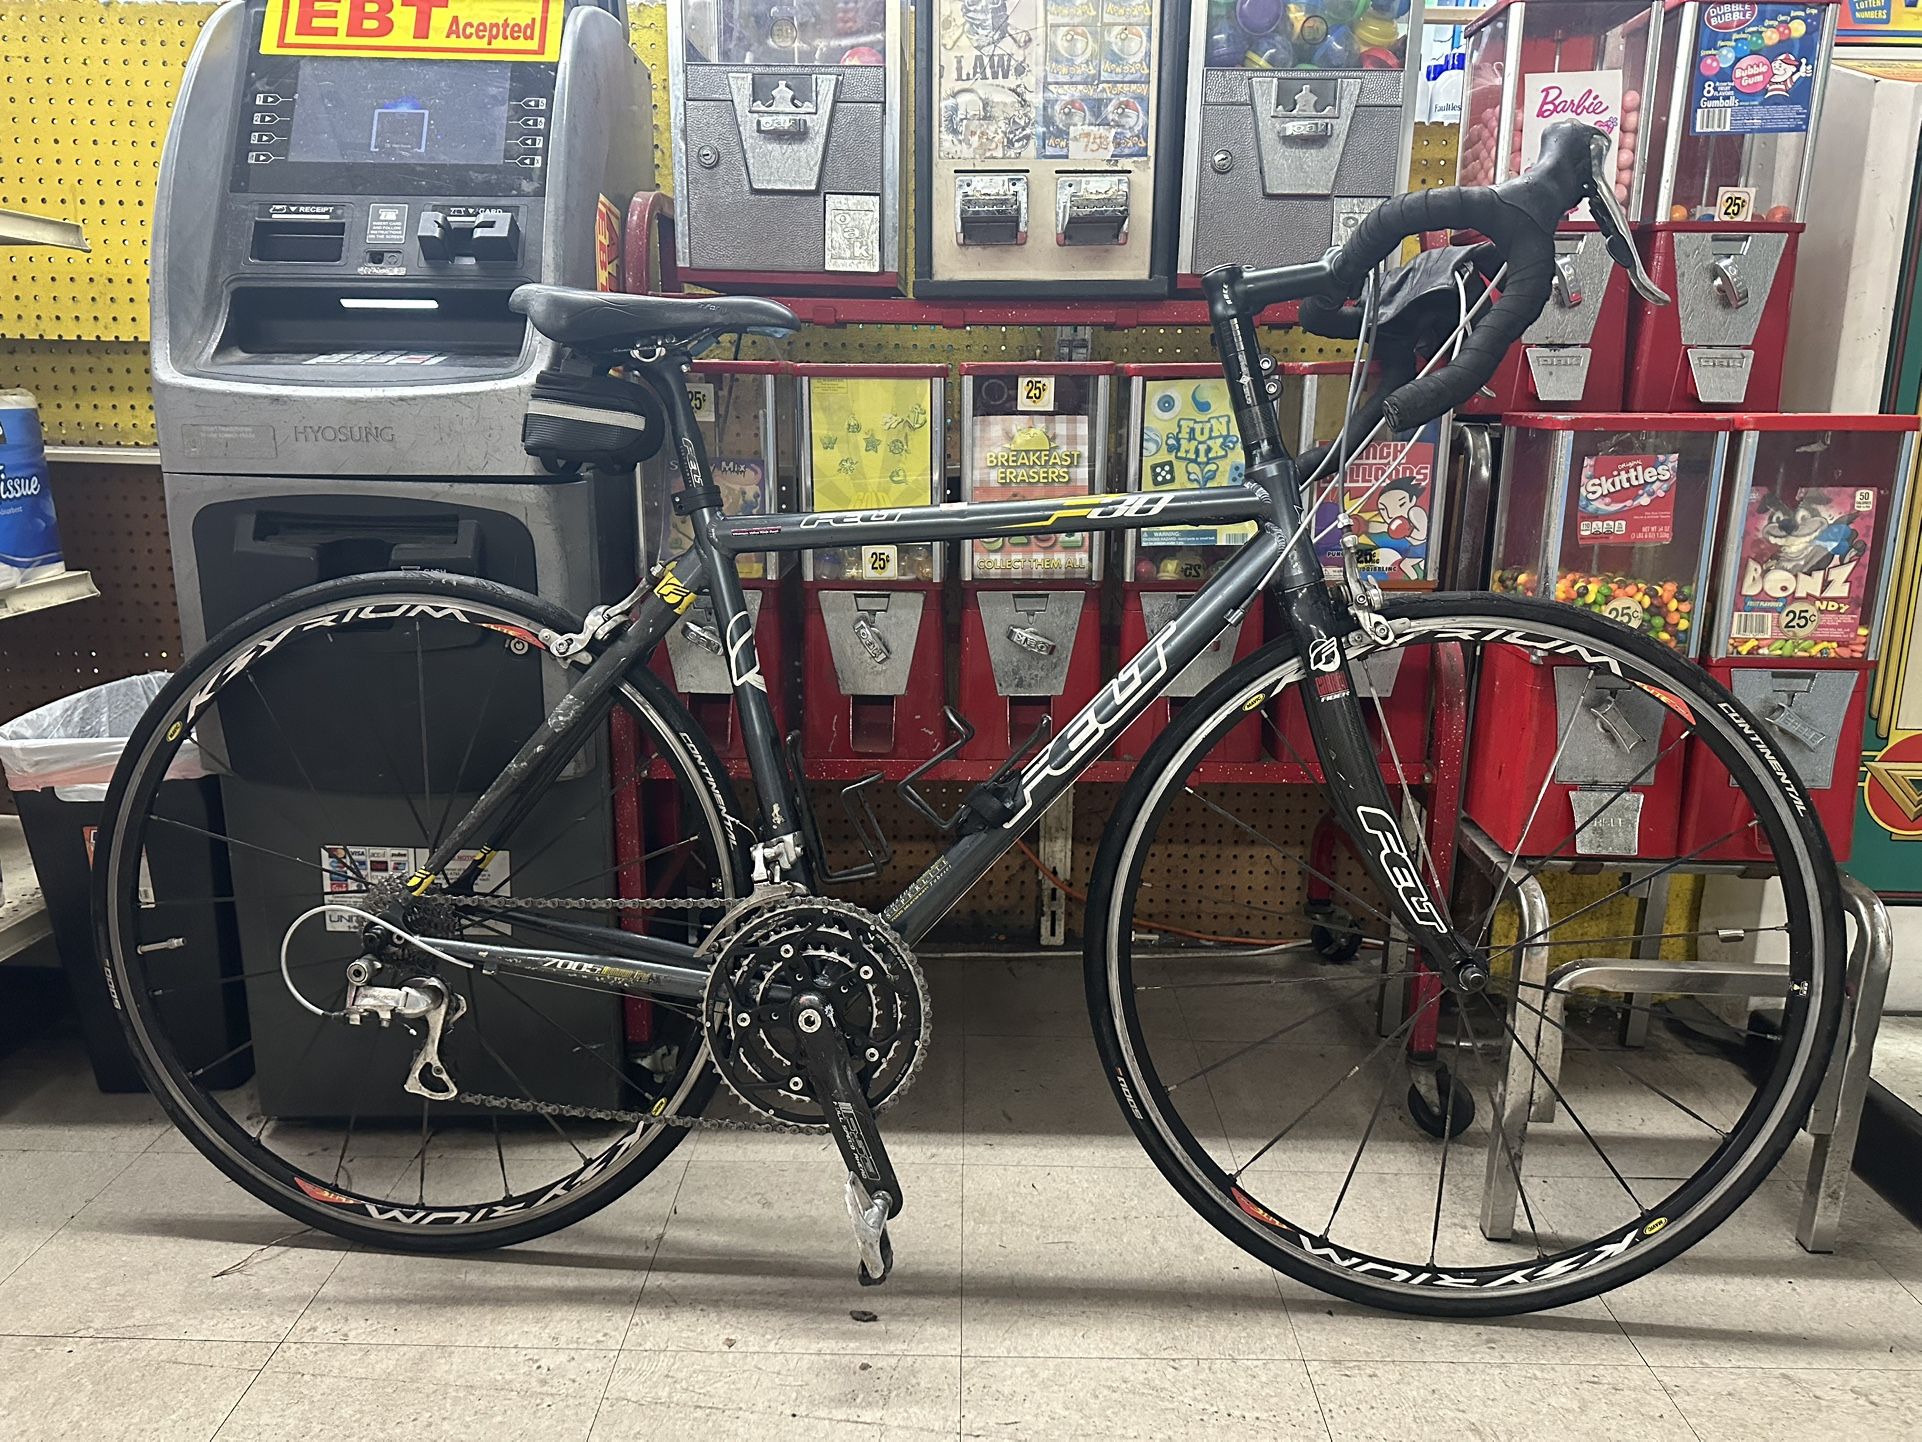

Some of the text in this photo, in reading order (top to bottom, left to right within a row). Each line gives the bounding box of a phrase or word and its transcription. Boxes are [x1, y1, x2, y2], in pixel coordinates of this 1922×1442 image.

[1709, 2, 1751, 17] DUBBLE
[1856, 0, 1886, 10] LOTTERY
[295, 0, 536, 46] EBT Acepted
[1710, 11, 1753, 26] BUBBLE
[1856, 10, 1887, 20] NUMBERS
[954, 54, 1013, 81] LAW
[1735, 62, 1768, 79] Bubble
[1703, 81, 1714, 97] 8
[1742, 74, 1764, 86] Gum
[1536, 86, 1609, 118] Barbie
[1700, 96, 1740, 108] Gumballs
[1724, 195, 1746, 217] 25¢
[1026, 380, 1046, 400] 25¢
[294, 425, 395, 442] HYOSUNG
[1178, 415, 1230, 441] FUN
[986, 450, 1080, 467] BREAKFAST
[1175, 437, 1229, 463] MIX
[721, 461, 748, 476] Mix
[997, 467, 1070, 483] ERASERS
[0, 466, 41, 499] issue
[1585, 464, 1671, 500] Skittles
[1859, 491, 1870, 500] 50
[870, 551, 891, 571] 25¢
[977, 558, 1086, 570] COLLECT THEM ALL
[1740, 556, 1858, 598] BONZ
[1608, 606, 1639, 624] 25¢
[1784, 610, 1816, 629] 25¢
[187, 604, 471, 722] KSYRIUM
[1245, 695, 1262, 709] MAVIC
[1717, 701, 1805, 818] CONTINENTAL
[680, 731, 739, 852] CONTINENTAL
[1357, 805, 1448, 935] FELT
[543, 957, 603, 974] 7005
[1299, 1229, 1639, 1287] KSYRIUM
